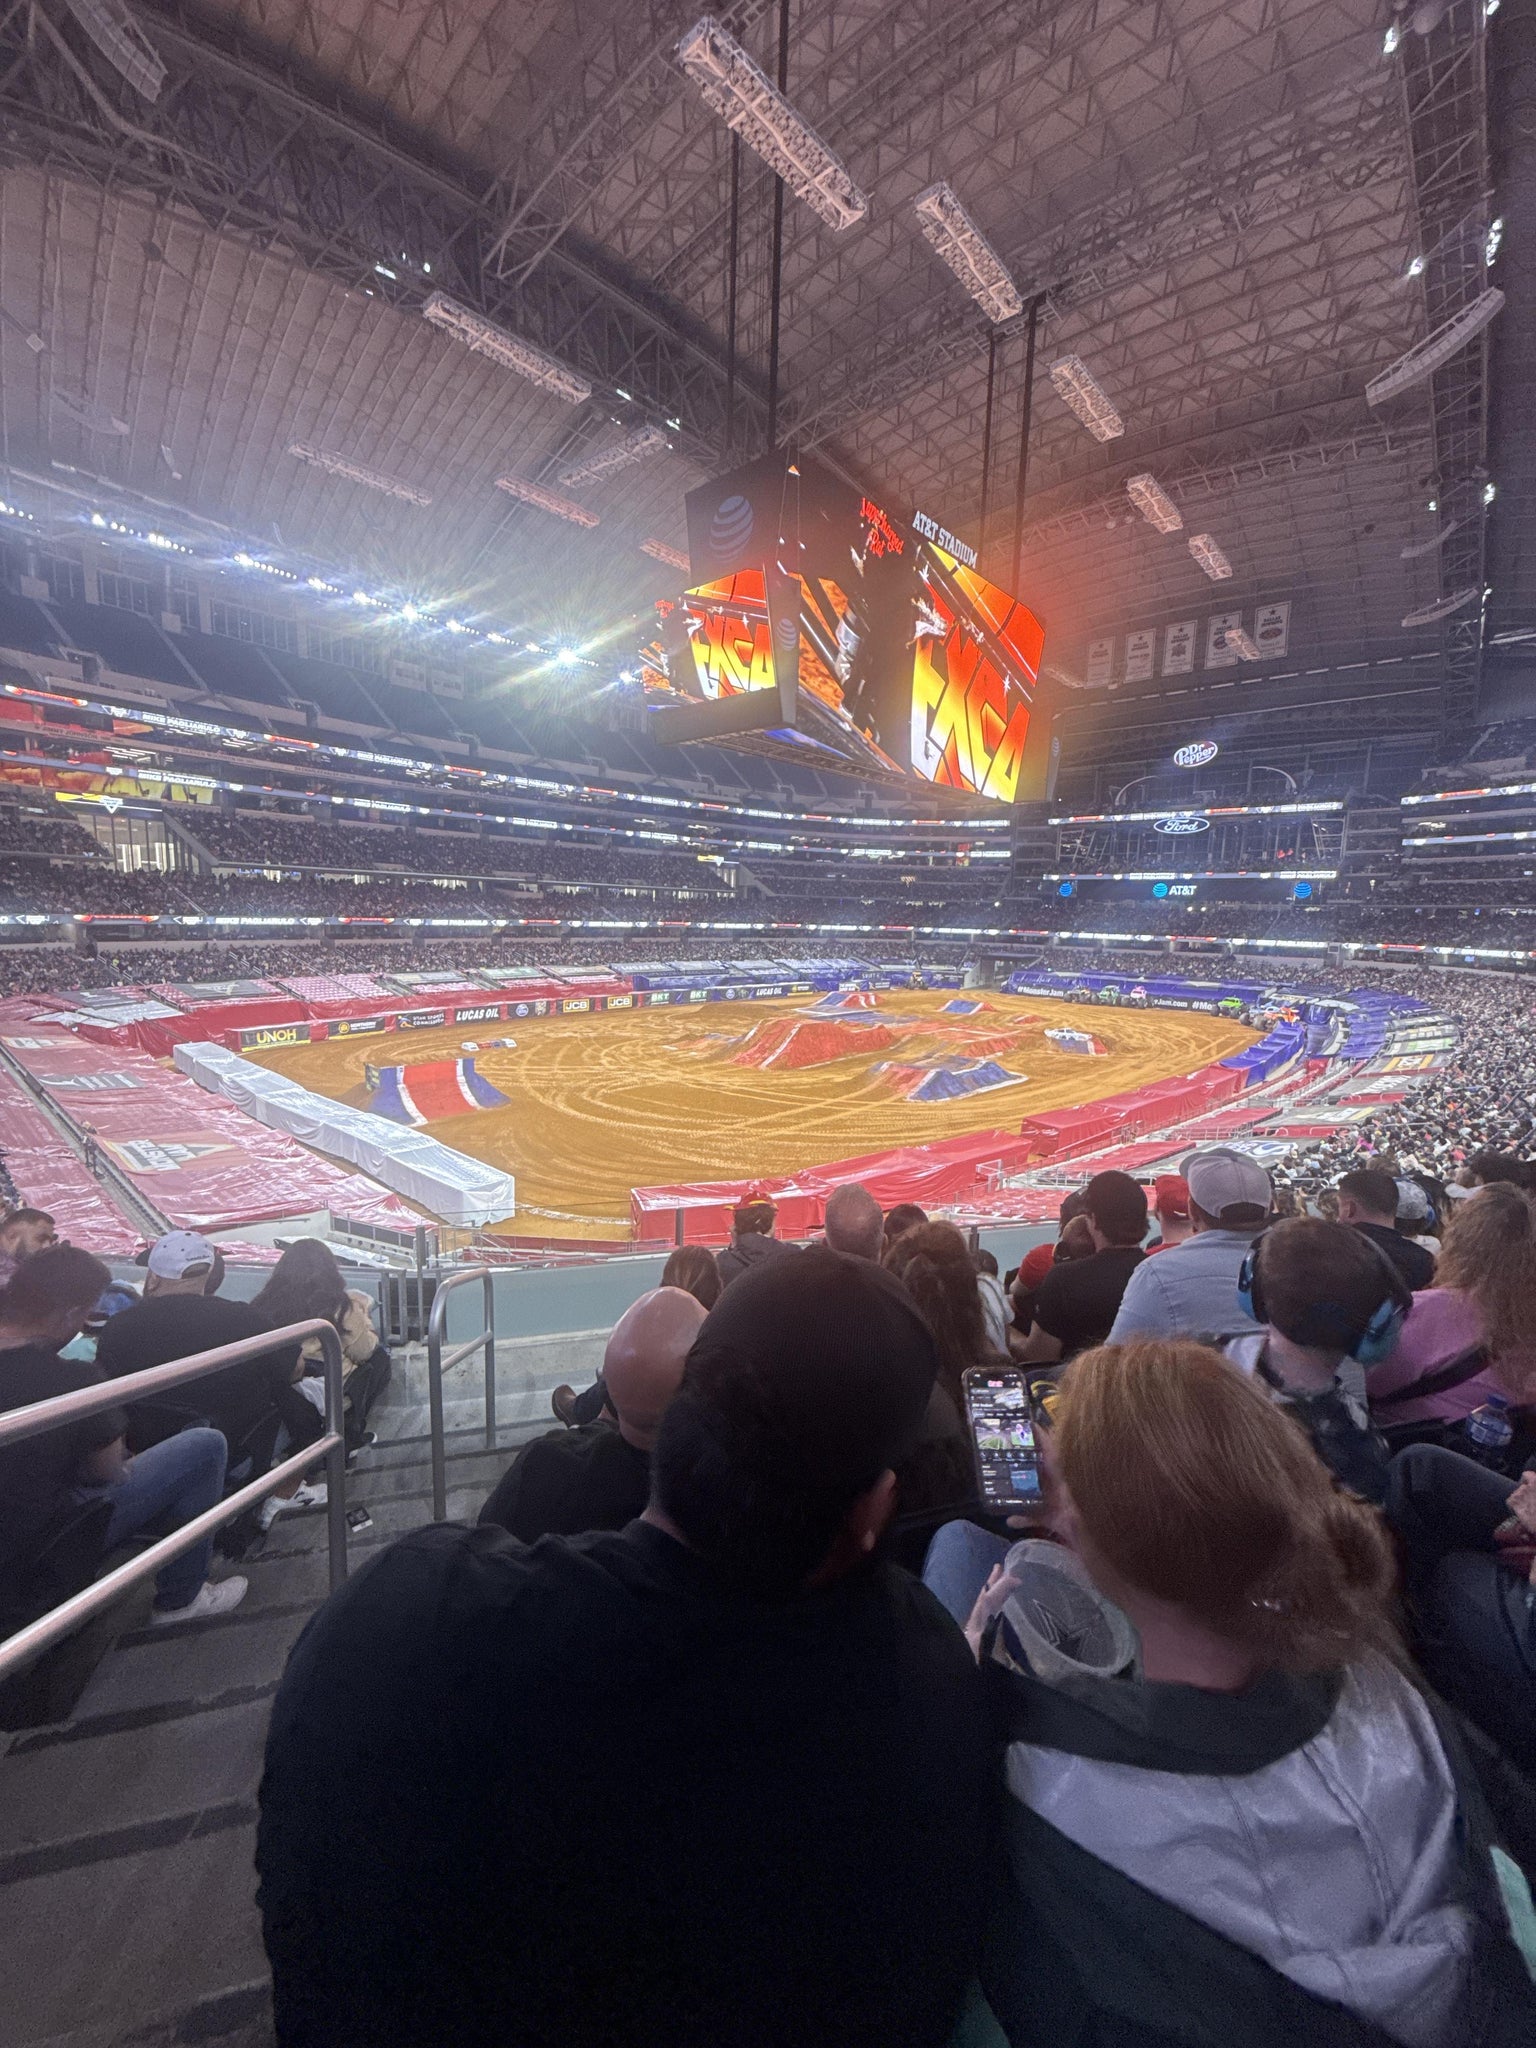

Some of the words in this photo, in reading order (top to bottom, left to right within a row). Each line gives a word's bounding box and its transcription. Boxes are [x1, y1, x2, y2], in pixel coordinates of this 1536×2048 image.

[912, 510, 939, 541] AT&T
[938, 527, 978, 569] STADIUM
[1188, 744, 1205, 755] Dr
[1179, 747, 1215, 766] Pepper
[1164, 819, 1198, 831] Ford
[1168, 885, 1197, 895] AT&T
[651, 993, 669, 1001] BKT
[690, 990, 708, 998] BKT
[756, 988, 774, 996] LUCAS
[1017, 986, 1064, 997] #MonsterJam
[565, 1002, 588, 1010] JCB
[609, 998, 631, 1007] JCB
[456, 1009, 485, 1022] LUCAS
[485, 1008, 499, 1018] OIL
[256, 1029, 297, 1044] UNOH
